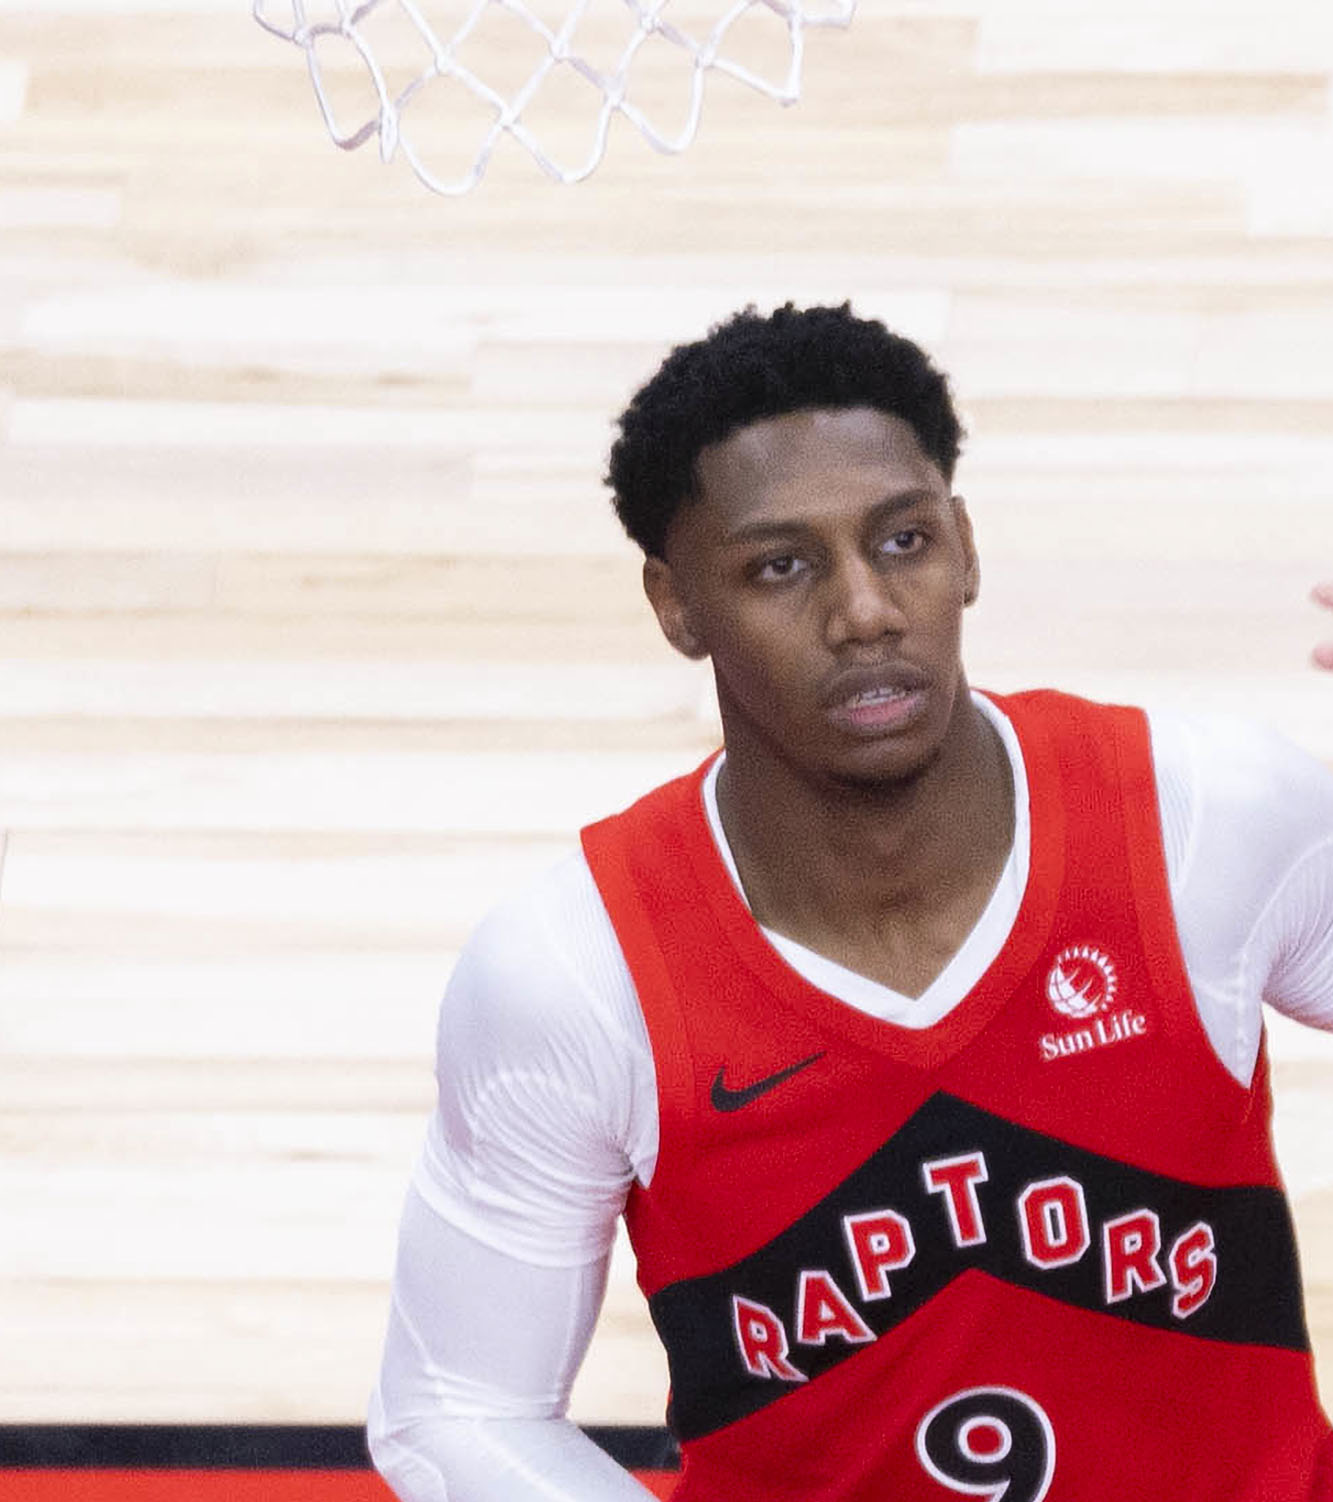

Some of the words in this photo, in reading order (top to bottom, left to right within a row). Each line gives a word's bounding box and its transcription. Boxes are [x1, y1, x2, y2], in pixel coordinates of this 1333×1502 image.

[1041, 1032, 1095, 1061] Sun
[1095, 1009, 1147, 1046] Life
[732, 1151, 1218, 1382] RAPTORS
